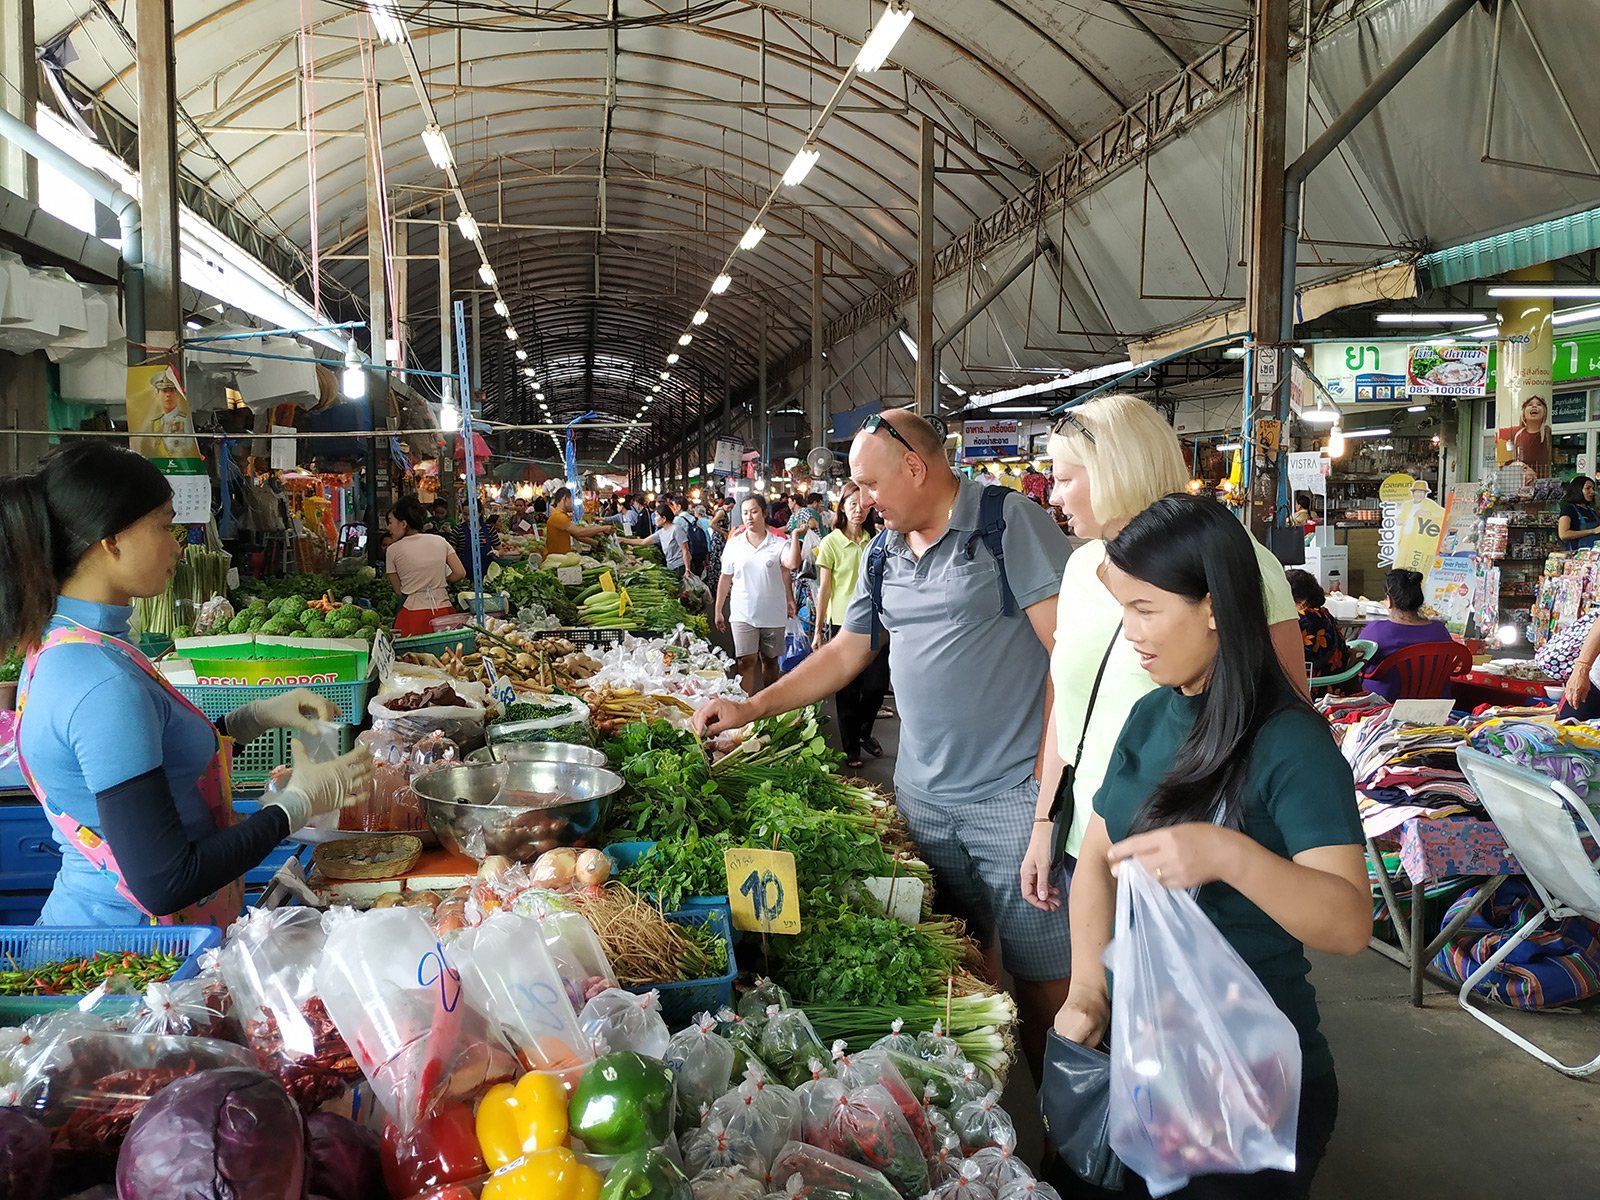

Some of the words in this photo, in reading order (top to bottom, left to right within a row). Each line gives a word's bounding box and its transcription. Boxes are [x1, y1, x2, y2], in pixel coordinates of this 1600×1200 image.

[1345, 346, 1380, 371] ยา
[1409, 386, 1481, 395] 085-1000561
[1290, 458, 1318, 469] VISTRA
[1377, 502, 1396, 568] Veldent
[740, 870, 784, 921] 10
